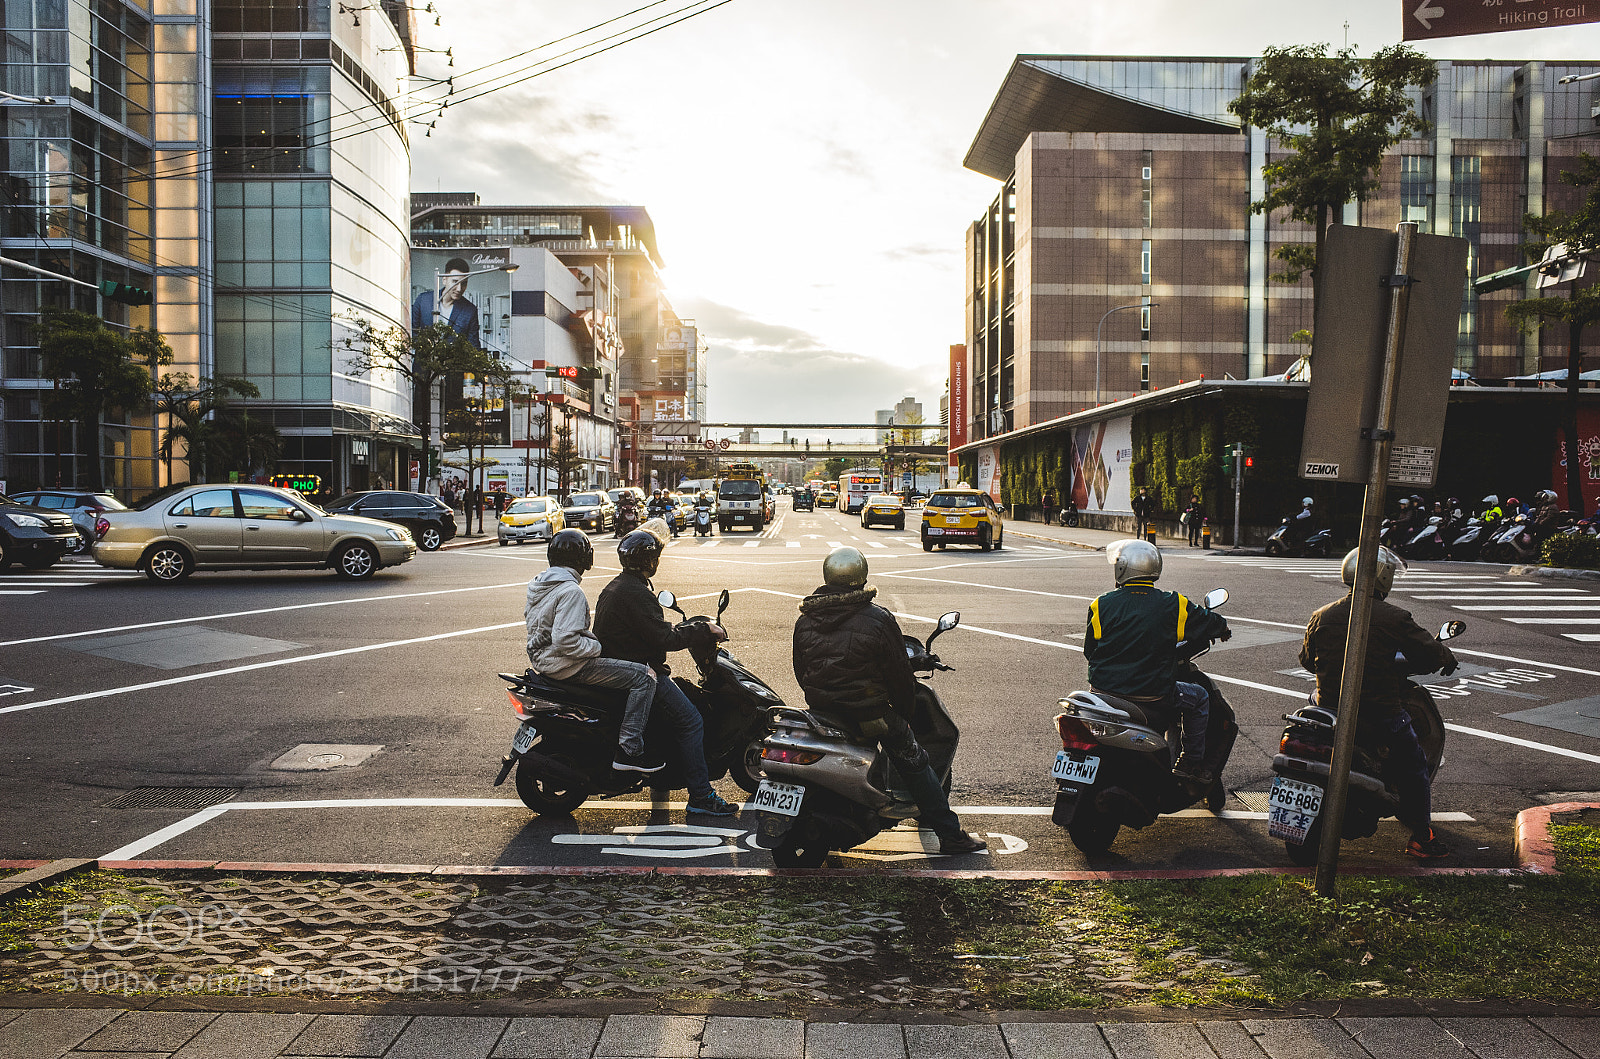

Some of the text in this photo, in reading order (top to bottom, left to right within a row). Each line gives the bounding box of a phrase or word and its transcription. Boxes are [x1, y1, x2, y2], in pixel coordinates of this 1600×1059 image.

[1499, 5, 1586, 24] Hiking Trail
[1305, 464, 1339, 476] ZEMOK
[755, 789, 800, 812] M9N-231
[1270, 786, 1320, 812] P66-886
